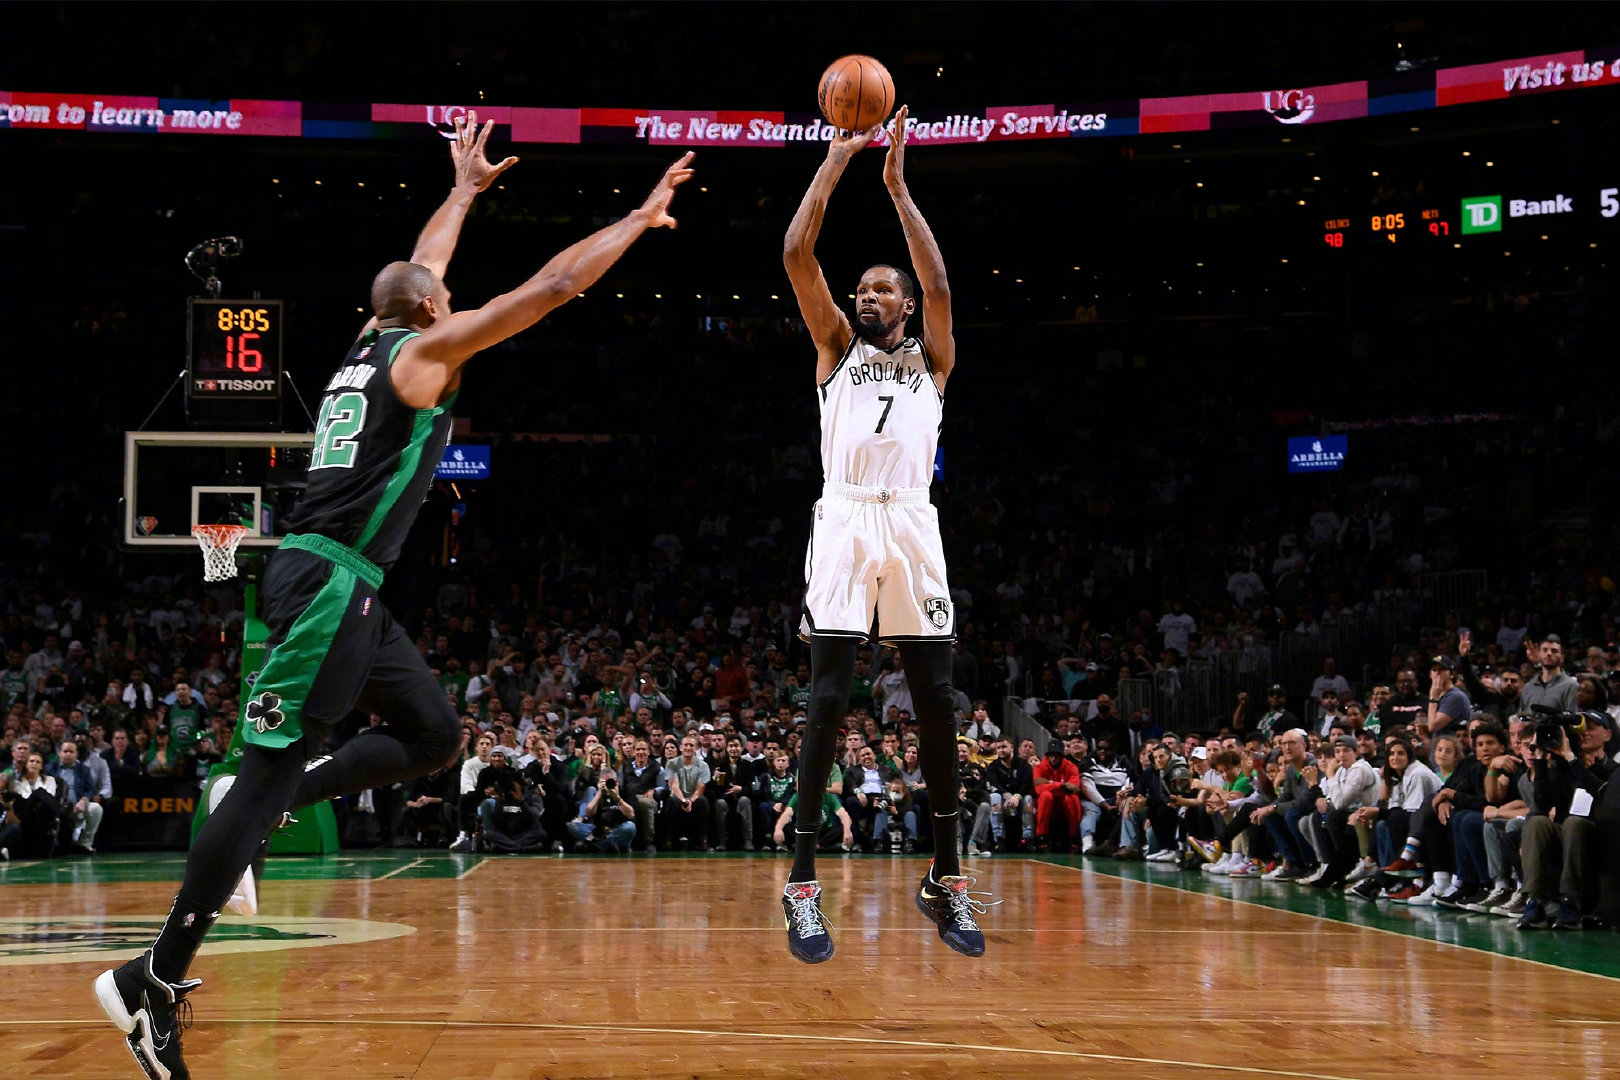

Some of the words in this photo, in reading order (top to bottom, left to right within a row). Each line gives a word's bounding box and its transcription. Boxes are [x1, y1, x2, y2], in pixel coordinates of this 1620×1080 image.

[1504, 62, 1567, 92] Visit
[1571, 60, 1605, 82] us
[57, 102, 86, 123] to
[91, 101, 164, 125] learn
[171, 109, 243, 129] more
[635, 115, 683, 139] The
[686, 117, 743, 140] New
[903, 115, 996, 142] Facility
[1000, 109, 1107, 136] Services
[1465, 202, 1498, 227] TD
[1509, 194, 1573, 217] Bank
[1371, 212, 1405, 232] 8:05
[1428, 221, 1450, 237] 97
[1324, 232, 1344, 248] 98
[218, 308, 269, 331] 8:05
[226, 333, 262, 372] 16
[217, 380, 275, 391] TISSOT
[849, 361, 924, 394] BROOKLYN
[874, 395, 894, 434] 7
[436, 461, 487, 469] RBELLA
[1291, 452, 1344, 462] ARBELLA
[926, 600, 951, 612] NETS
[123, 798, 194, 813] RDEN
